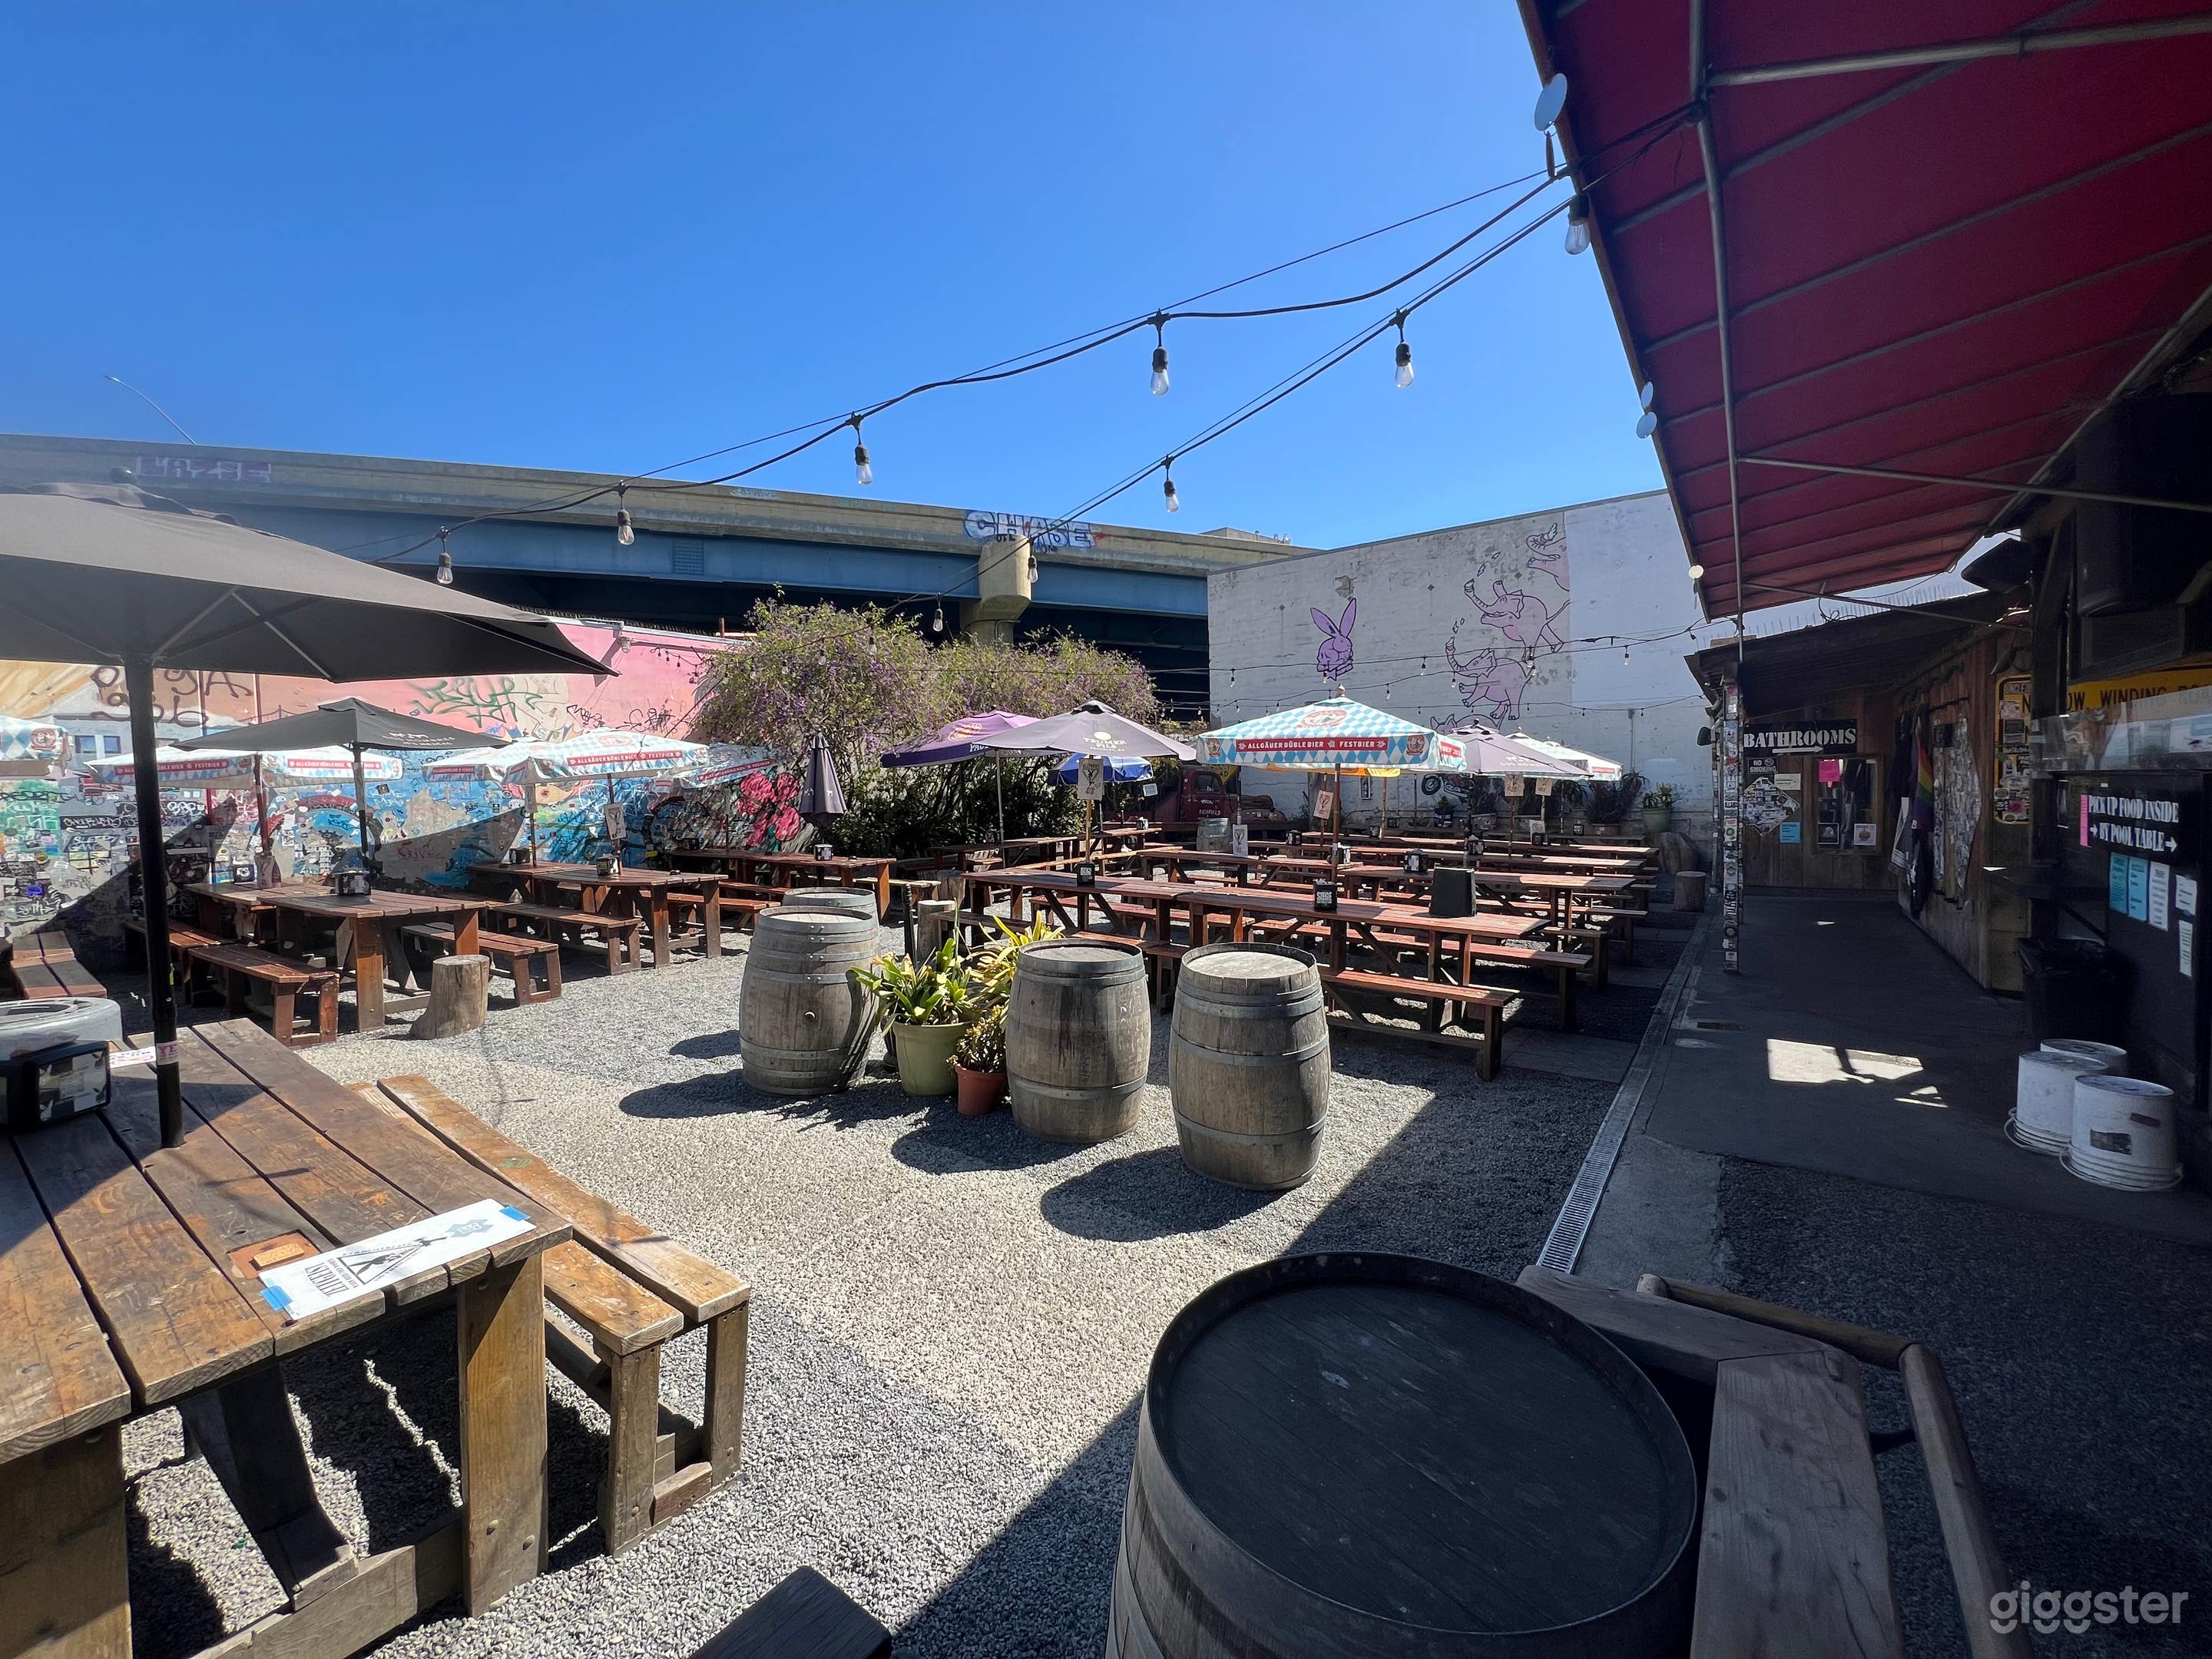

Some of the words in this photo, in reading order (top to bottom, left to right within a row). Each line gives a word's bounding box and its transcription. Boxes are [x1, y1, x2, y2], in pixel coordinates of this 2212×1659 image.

[1247, 741, 1283, 750] ALLGÄUER
[1743, 728, 1856, 748] BATHROOMS
[2088, 794, 2105, 813] PICK
[2107, 796, 2118, 816] UP
[2119, 797, 2143, 819] FOOD
[2145, 800, 2179, 823] INSIDE
[2099, 822, 2110, 841] BY
[2111, 823, 2133, 846] POOL
[2134, 827, 2165, 852] TABLE
[304, 1262, 349, 1297] ZEITGEIST
